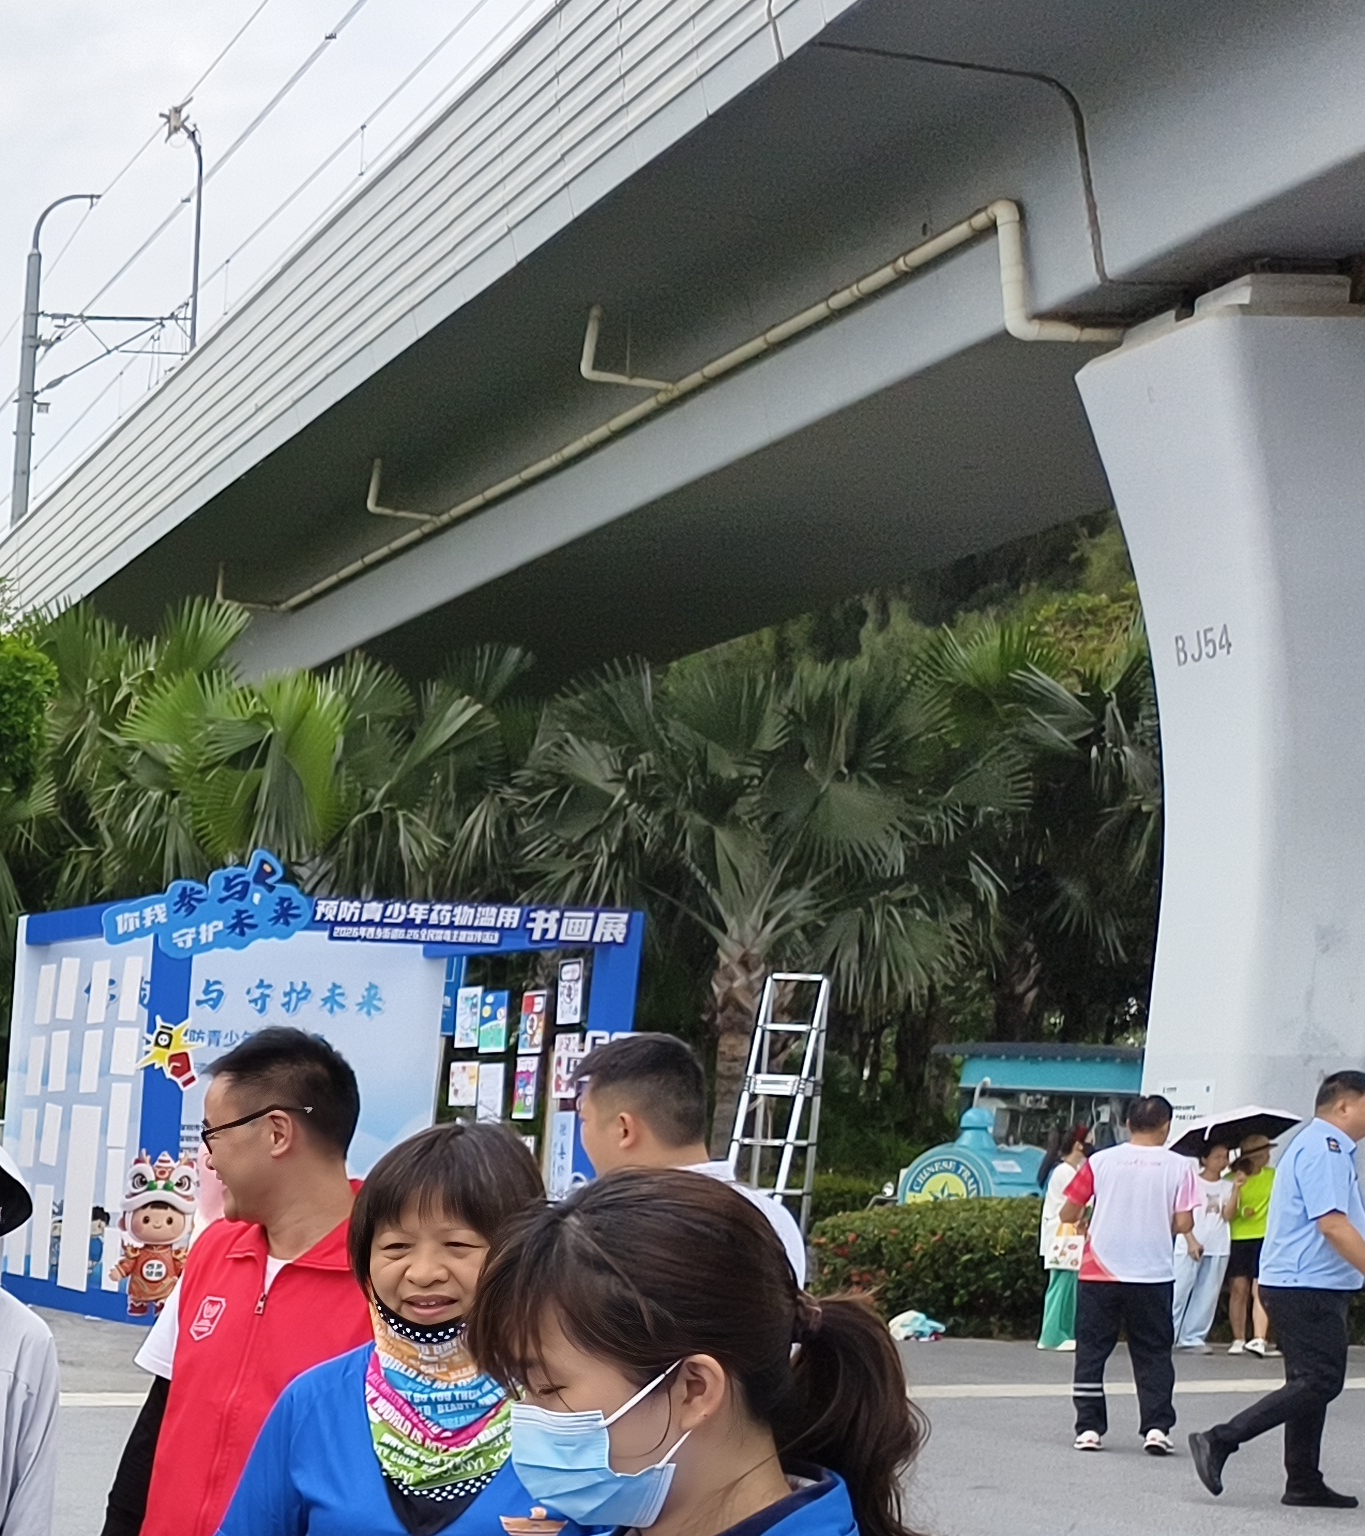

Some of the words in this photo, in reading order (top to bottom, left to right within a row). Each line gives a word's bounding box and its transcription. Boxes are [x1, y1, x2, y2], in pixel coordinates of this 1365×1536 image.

[1174, 623, 1232, 667] BJ54
[314, 899, 520, 929] 预防青少年药物滥用
[526, 910, 629, 943] 书画展
